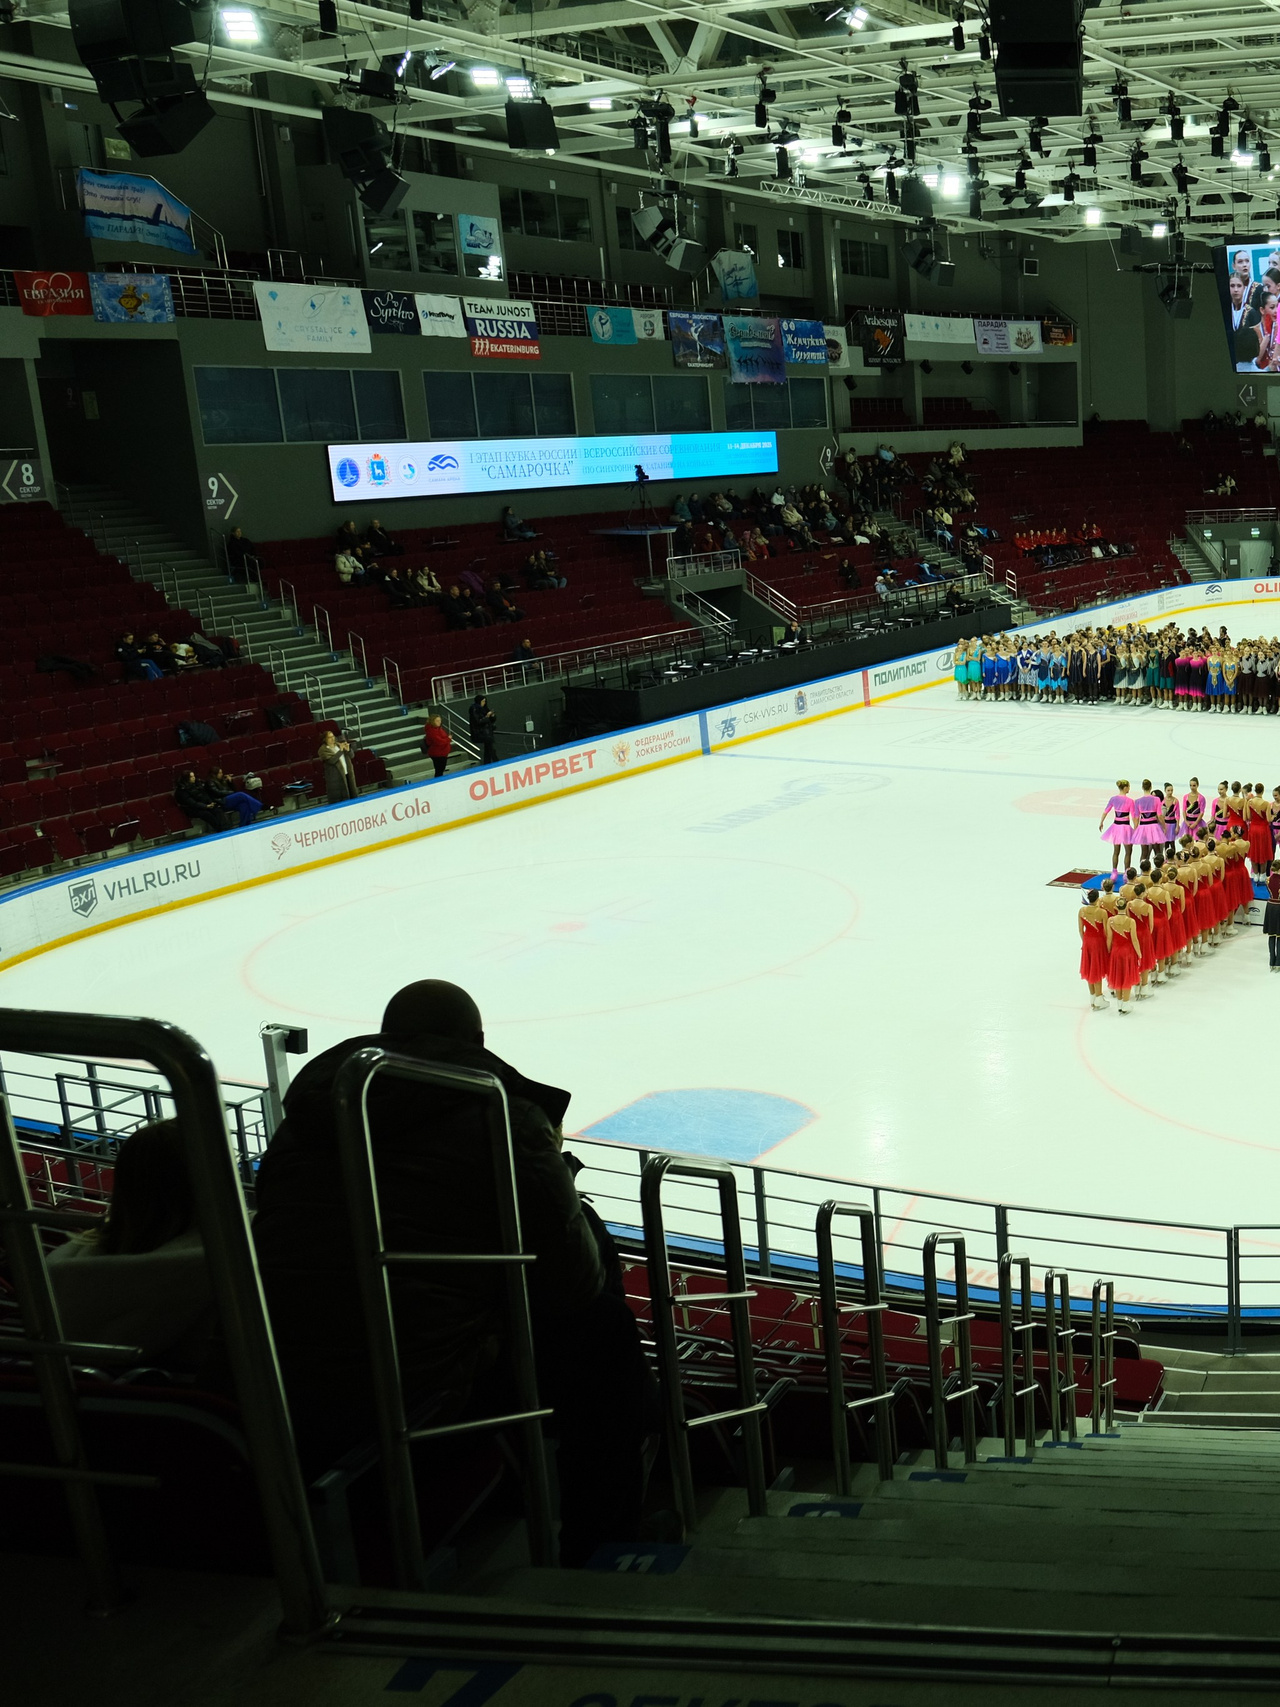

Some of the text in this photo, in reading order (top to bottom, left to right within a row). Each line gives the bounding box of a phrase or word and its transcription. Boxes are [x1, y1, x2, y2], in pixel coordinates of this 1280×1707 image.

[24, 288, 85, 300] ЕВРАЗИЯ
[371, 297, 415, 325] Synchro
[467, 303, 532, 318] TEAM JUNOST
[294, 326, 329, 334] CRYSTAL
[475, 319, 533, 340] RUSSIA
[863, 315, 899, 329] Arabesque
[977, 320, 1008, 329] ПАРАДИЗ
[307, 335, 334, 343] FAMILY
[490, 344, 541, 356] EKATERINBURG
[476, 452, 500, 464] ЭТАП
[501, 451, 538, 463] КУБКА
[539, 449, 578, 462] РОССИИ
[584, 445, 658, 459] ВСЕРОССИЙСКИЕ
[21, 463, 35, 487] 8
[207, 476, 219, 499] 9
[873, 660, 928, 687] ПОЛИПЛАСТ
[743, 703, 789, 725] CSK-VVS.RU
[635, 730, 675, 748] ФЕДЕРАЦИЯ
[636, 735, 691, 759] ХОККЕЯ РОССИИ
[469, 749, 597, 802] OLIMPBET
[293, 797, 431, 849] ЧЕРНОГОЛОВКА Cola
[103, 859, 201, 902] VHLRU.RU
[617, 1552, 657, 1573] 11
